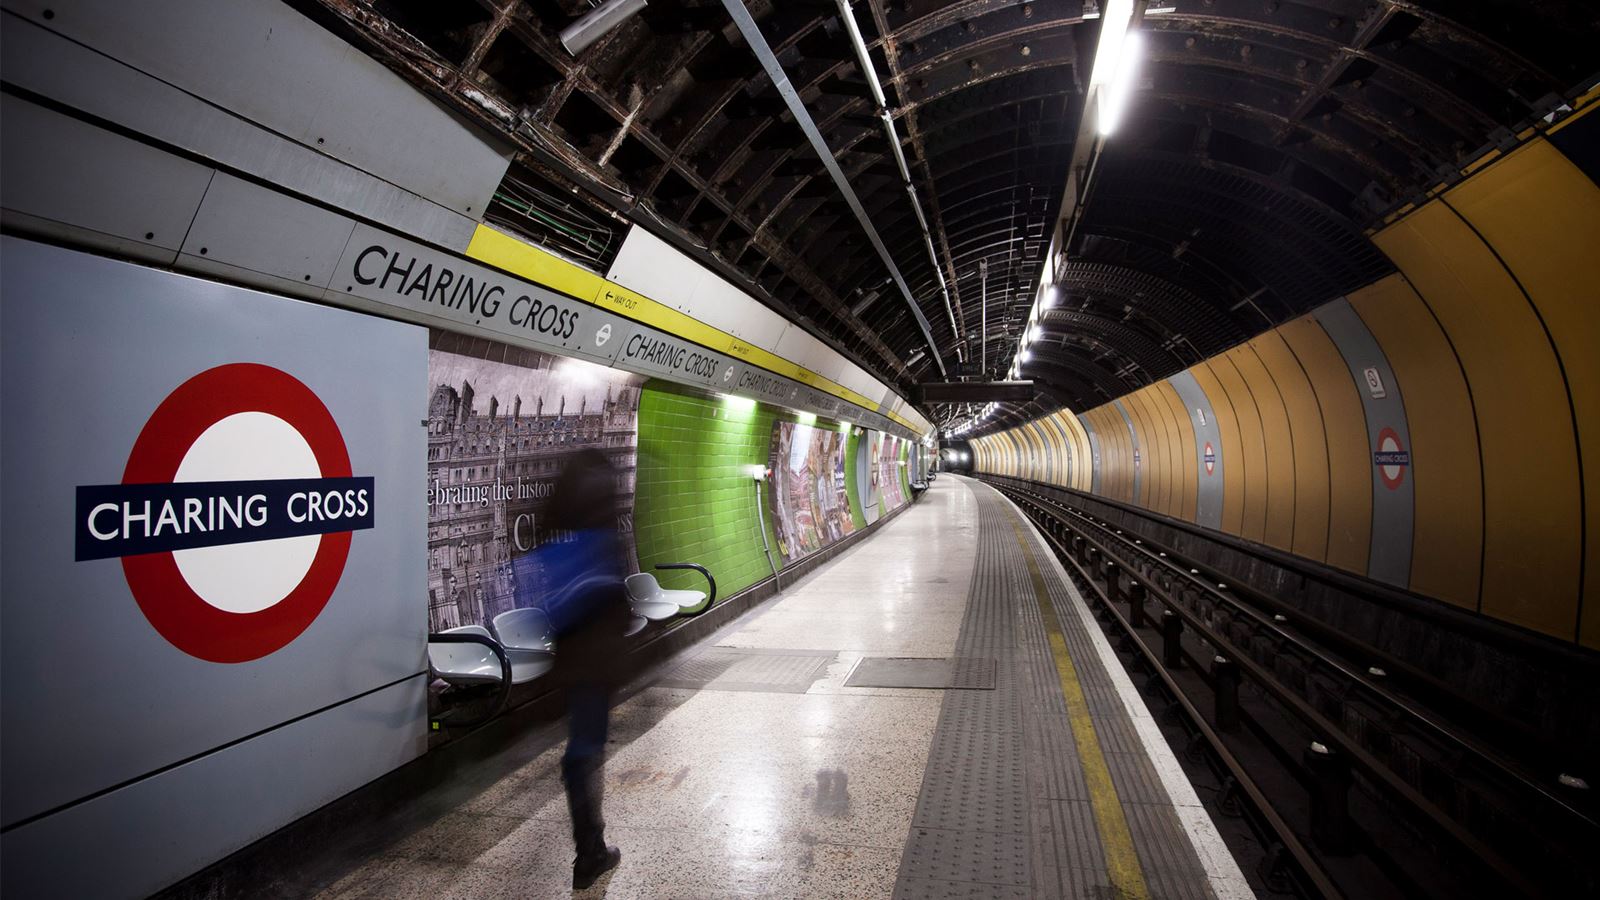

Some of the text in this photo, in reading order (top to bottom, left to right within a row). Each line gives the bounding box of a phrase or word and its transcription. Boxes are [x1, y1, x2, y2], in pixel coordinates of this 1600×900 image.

[353, 245, 578, 340] CHARING CROSS
[614, 294, 638, 310] WAY OUT
[626, 333, 719, 378] CHARING CROSS
[427, 479, 489, 507] ebrating
[492, 477, 514, 500] the
[87, 489, 369, 541] CHARING CROSS
